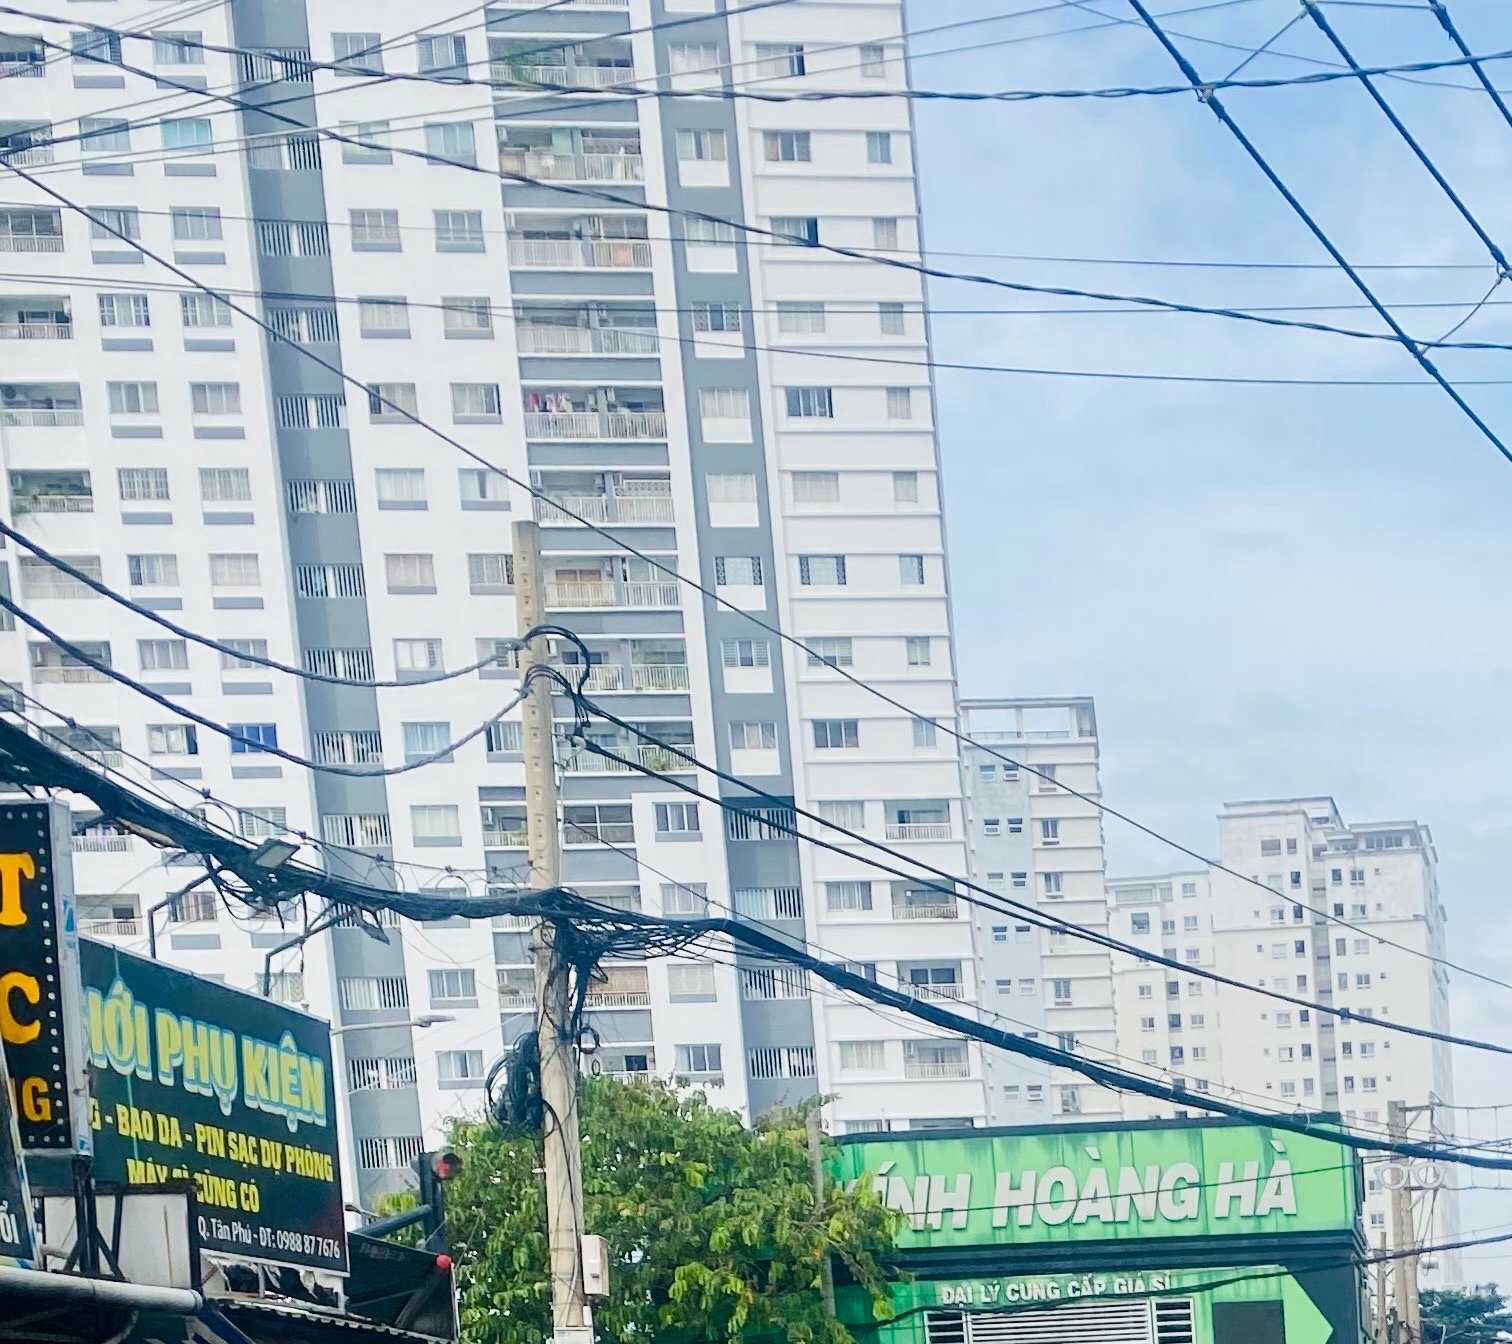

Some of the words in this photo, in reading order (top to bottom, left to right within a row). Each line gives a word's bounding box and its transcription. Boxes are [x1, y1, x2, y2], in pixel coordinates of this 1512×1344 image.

[155, 1008, 237, 1115] PHỤ
[241, 1029, 327, 1133] KIỆN
[116, 1103, 153, 1142] BAO
[157, 1112, 183, 1148] DA
[195, 1122, 225, 1158] PIN
[227, 1132, 258, 1168] SẠC
[285, 1143, 334, 1182] PHÒNG
[239, 1178, 260, 1213] CÓ
[866, 1160, 972, 1231] ÍNH
[992, 1146, 1200, 1227] HOÀNG
[1214, 1141, 1297, 1219] HÀ
[198, 1215, 211, 1240] Q.
[211, 1217, 231, 1241] Tân
[277, 1230, 302, 1252] 0988
[304, 1236, 317, 1254] 87
[318, 1238, 341, 1259] 7676
[978, 1277, 1001, 1302] LÝ
[1006, 1280, 1061, 1302] CUNG
